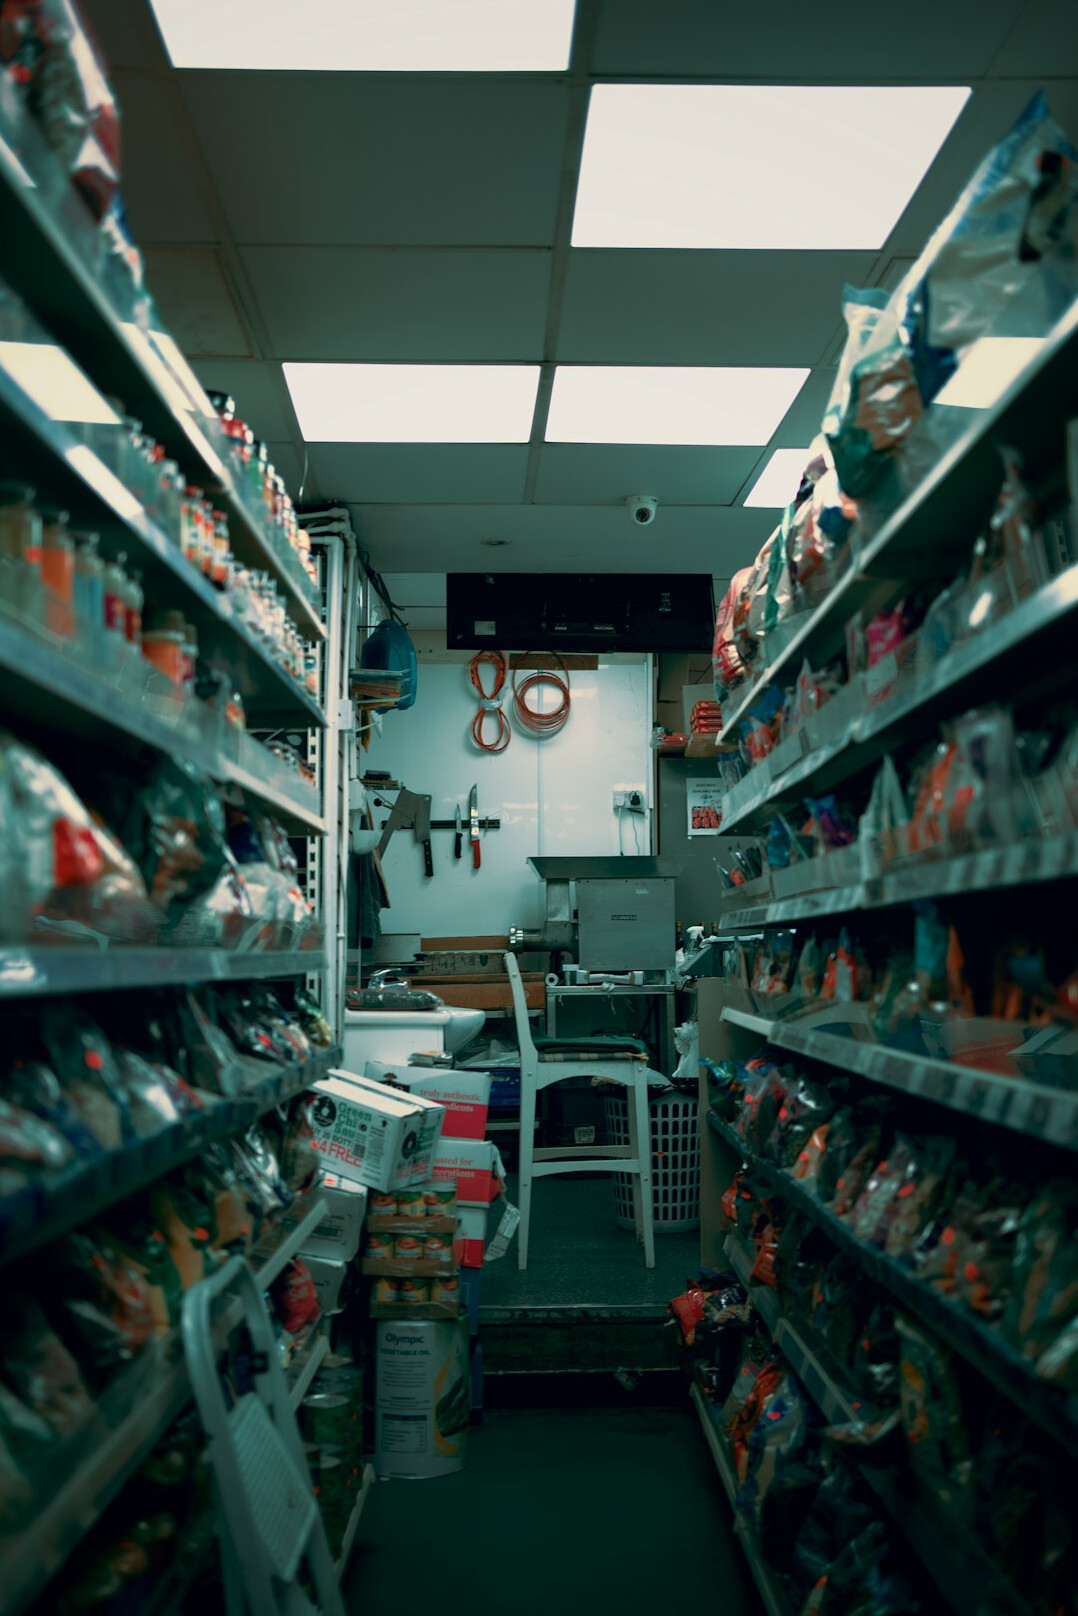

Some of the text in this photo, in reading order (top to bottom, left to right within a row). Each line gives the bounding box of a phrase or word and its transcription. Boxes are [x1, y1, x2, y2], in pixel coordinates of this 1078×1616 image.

[420, 1089, 481, 1101] truly authentic
[337, 1102, 373, 1123] Green
[446, 1102, 474, 1112] dients
[337, 1114, 358, 1129] Chi
[334, 1123, 356, 1139] Sau
[319, 1140, 363, 1168] 4 FREE
[434, 1157, 473, 1166] usted for
[385, 1333, 425, 1346] Olympic
